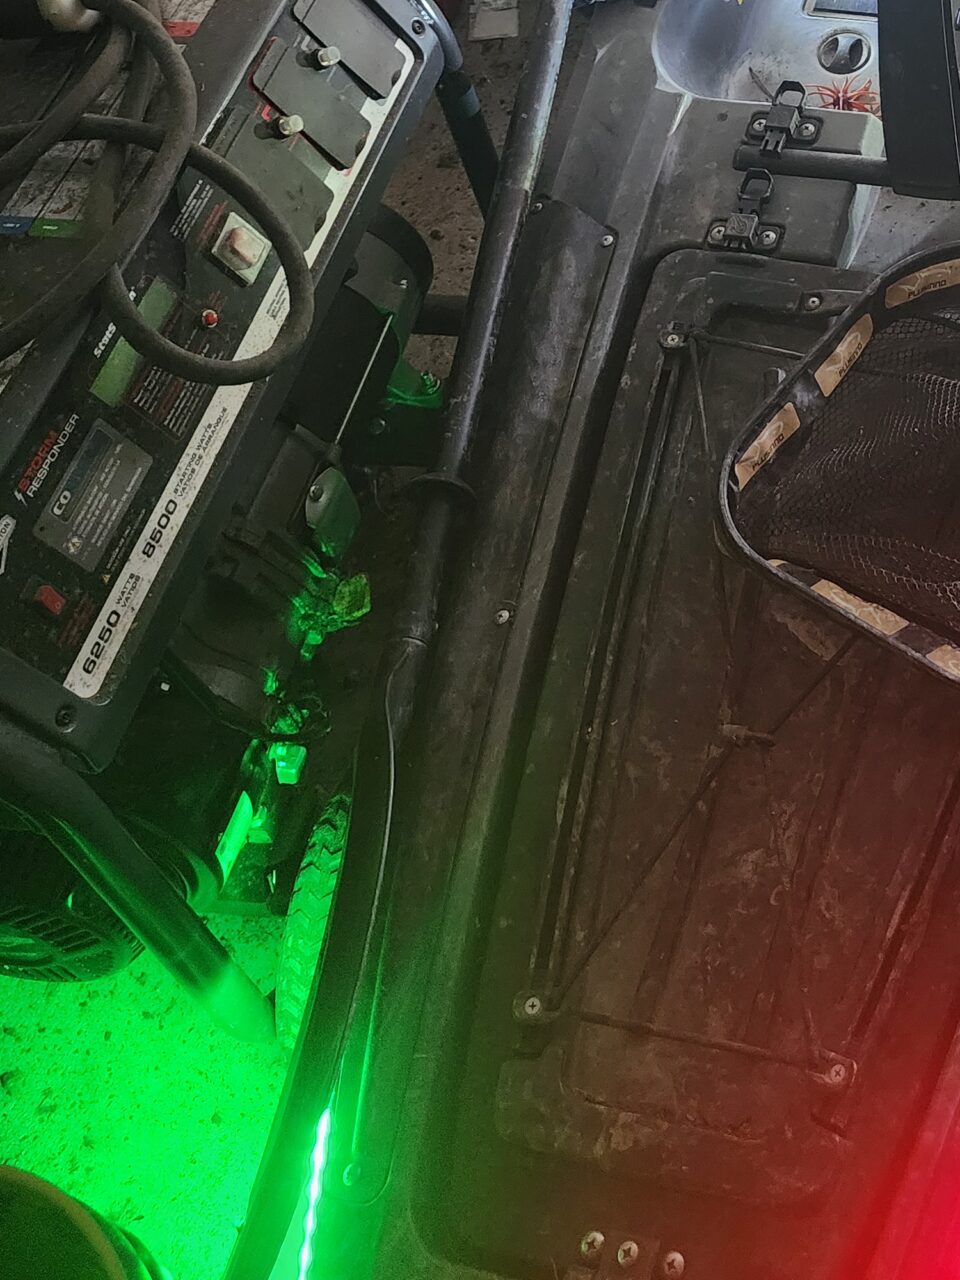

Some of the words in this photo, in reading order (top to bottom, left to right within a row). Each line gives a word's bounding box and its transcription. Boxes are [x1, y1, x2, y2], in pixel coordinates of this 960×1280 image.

[907, 279, 947, 299] PLUSINNO
[18, 429, 59, 493] STORM
[26, 413, 80, 498] RESPONDER
[173, 452, 198, 495] STARTING
[142, 498, 178, 559] 8500
[115, 572, 136, 605] WATTS
[82, 610, 121, 675] 6250
